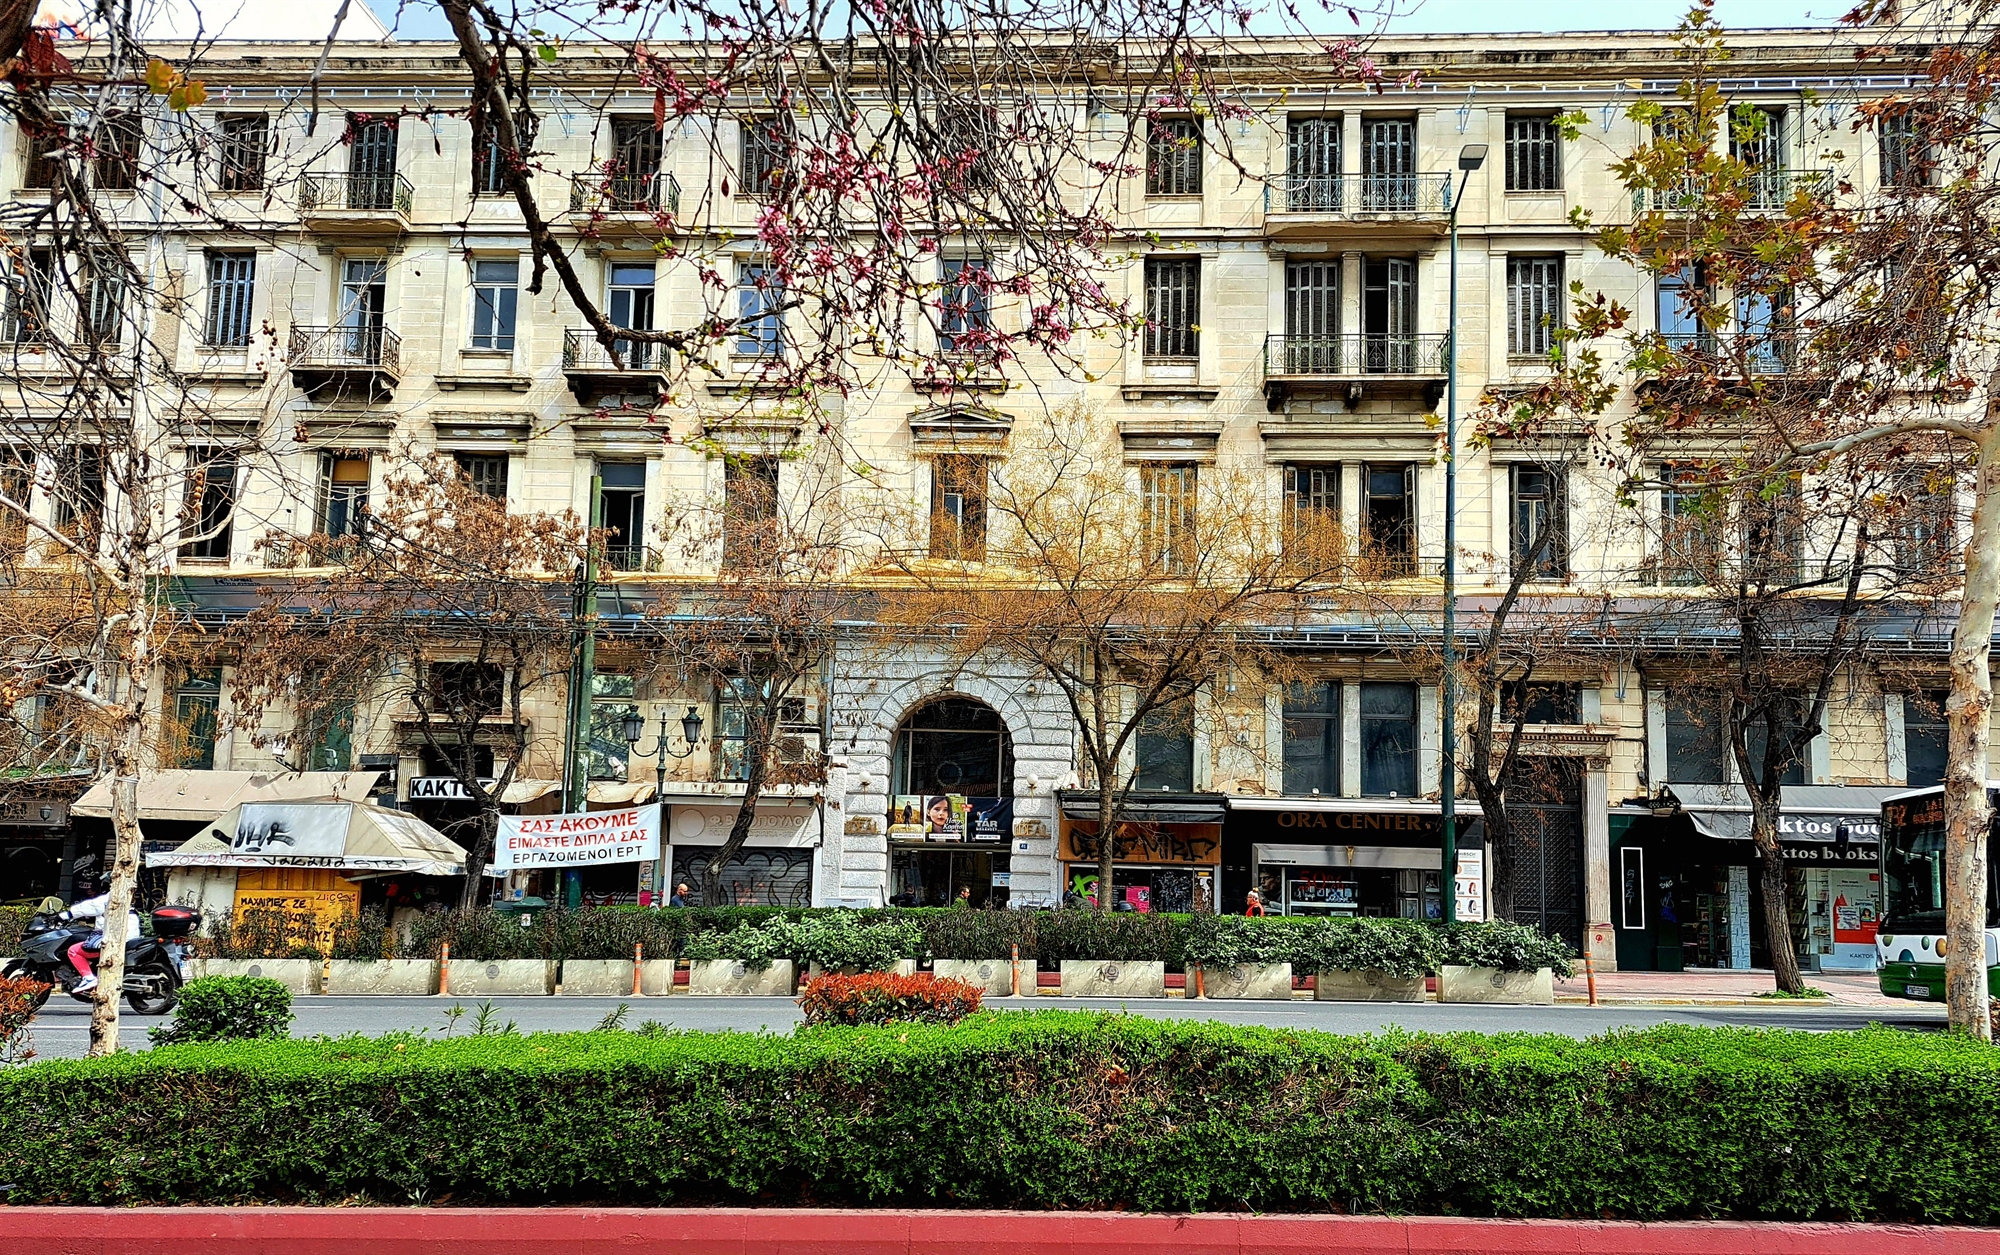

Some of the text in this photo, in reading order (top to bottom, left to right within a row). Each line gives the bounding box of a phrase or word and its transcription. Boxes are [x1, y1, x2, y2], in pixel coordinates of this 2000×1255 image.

[411, 780, 493, 797] ΚΑΚΤΟ
[519, 811, 638, 833] ΣΑΣ ΑΚΟΥΜΕ
[974, 817, 998, 828] TÁR
[1277, 812, 1421, 831] ORA CENTER
[1749, 815, 1832, 834] ktos
[508, 829, 648, 849] ΕΙΜΑΣΤΕ ΔΙΠΛΑ ΣΑΣ
[513, 845, 643, 864] ΕΡΓΑΖΟΜΕΝΟΙ ΕΡΤ
[1822, 846, 1878, 860] boks
